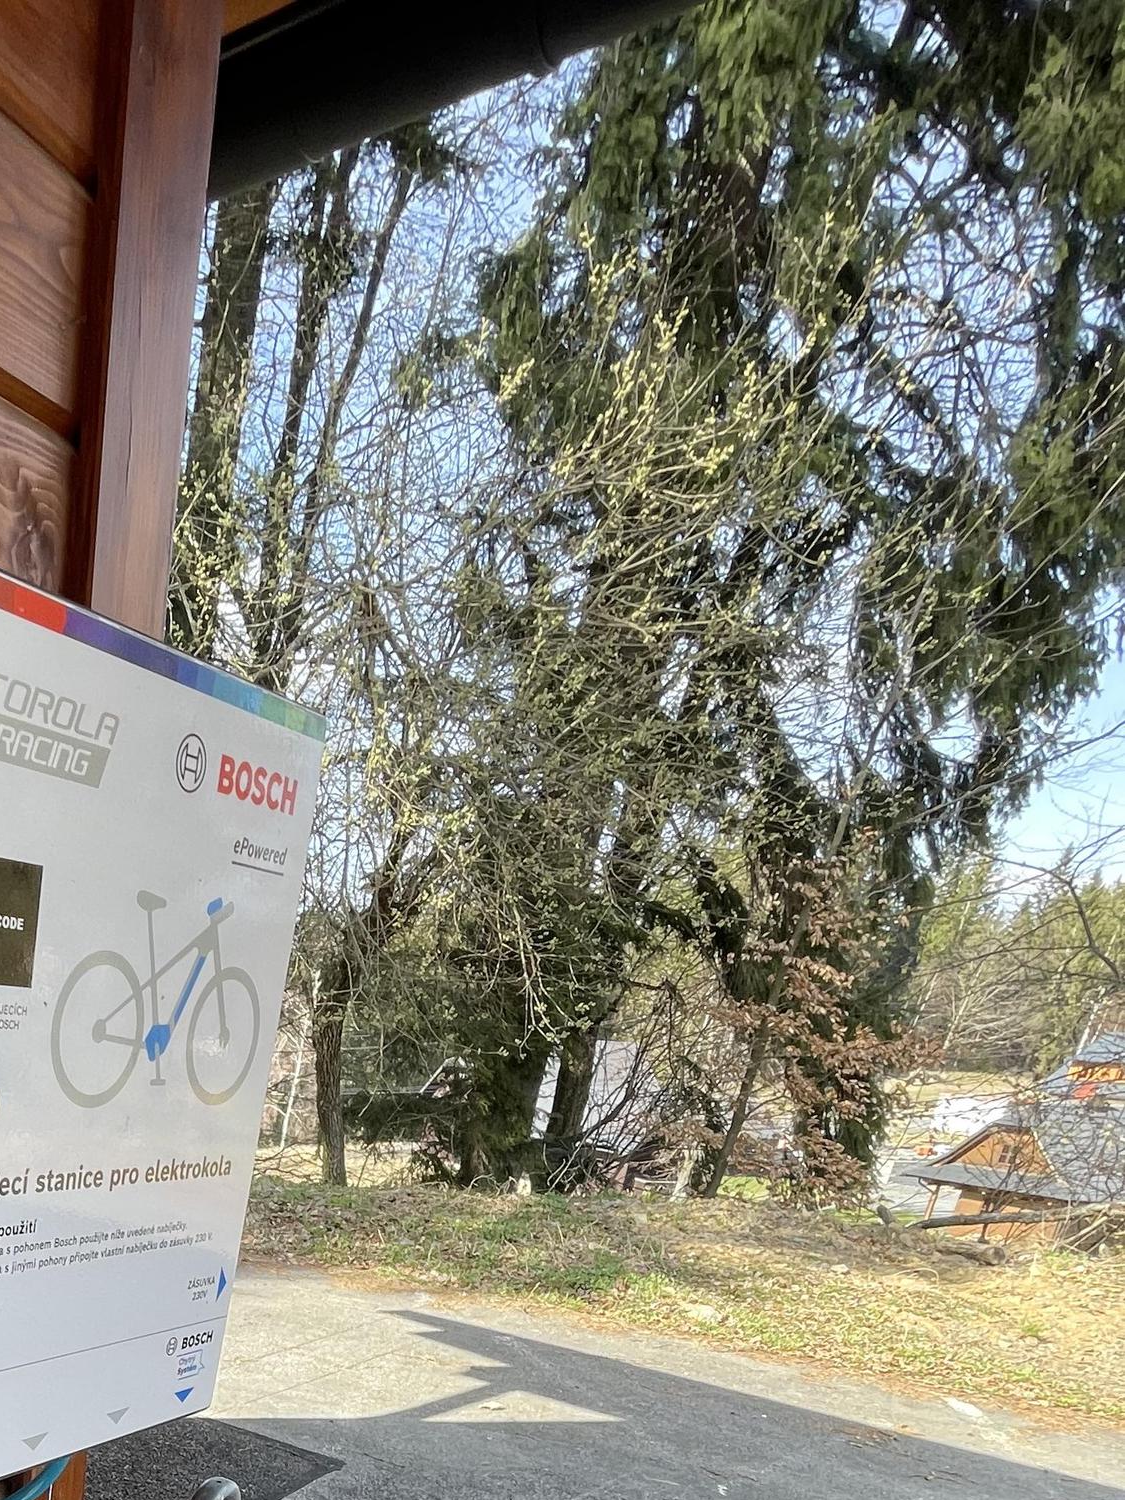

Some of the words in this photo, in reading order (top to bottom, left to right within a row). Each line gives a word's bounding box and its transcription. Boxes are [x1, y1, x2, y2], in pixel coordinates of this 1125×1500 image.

[216, 754, 298, 816] BOSCH
[233, 836, 288, 866] ePowered
[35, 1164, 104, 1193] stanice
[109, 1166, 139, 1191] pro
[144, 1154, 232, 1184] elektrokola
[11, 1258, 37, 1275] jinými
[38, 1253, 68, 1270] pohony
[69, 1249, 99, 1265] připojte
[100, 1245, 125, 1258] vlastní
[126, 1240, 158, 1256] nabíječku
[159, 1239, 168, 1249] do
[169, 1236, 194, 1248] zásuvky
[195, 1233, 207, 1243] 230
[13, 1239, 52, 1255] pohonem
[54, 1235, 78, 1248] Bosch
[79, 1231, 109, 1247] použijte
[110, 1229, 125, 1241] níže
[127, 1224, 155, 1238] uvedené
[188, 1276, 215, 1290] ZÁSUVKA
[192, 1290, 208, 1301] 230V
[181, 1330, 214, 1350] BOSCH
